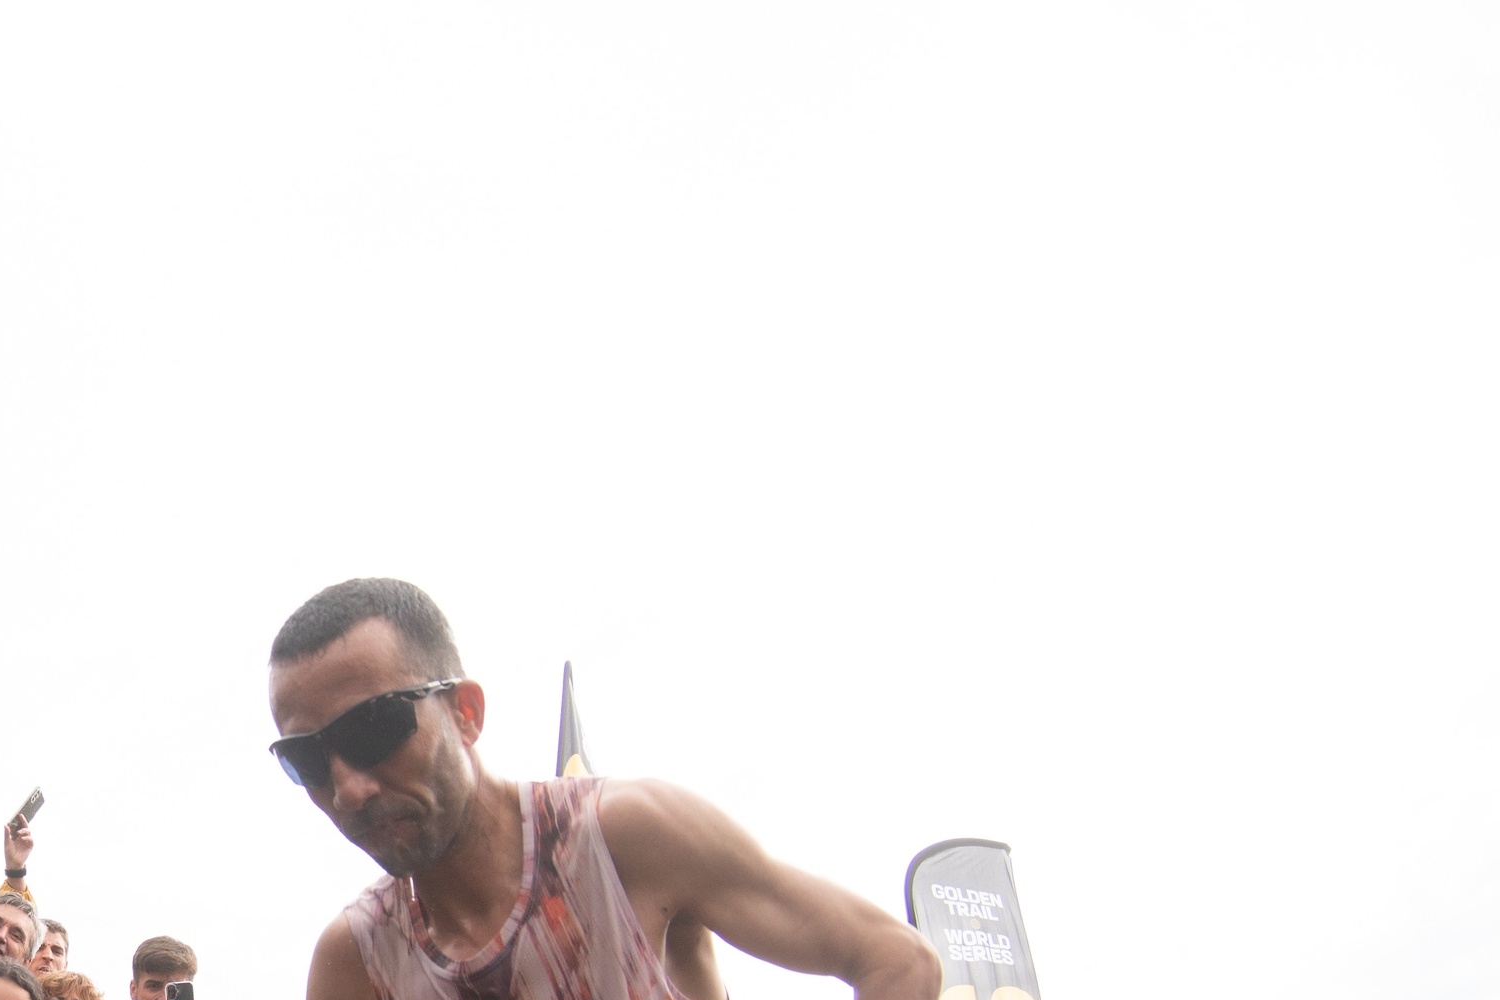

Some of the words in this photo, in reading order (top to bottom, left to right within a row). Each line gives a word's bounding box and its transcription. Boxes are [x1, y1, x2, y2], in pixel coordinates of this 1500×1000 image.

[931, 884, 1004, 909] GOLDEN
[943, 899, 999, 922] TRAIL
[943, 928, 1011, 950] WORLD
[948, 943, 1015, 966] SERIES
